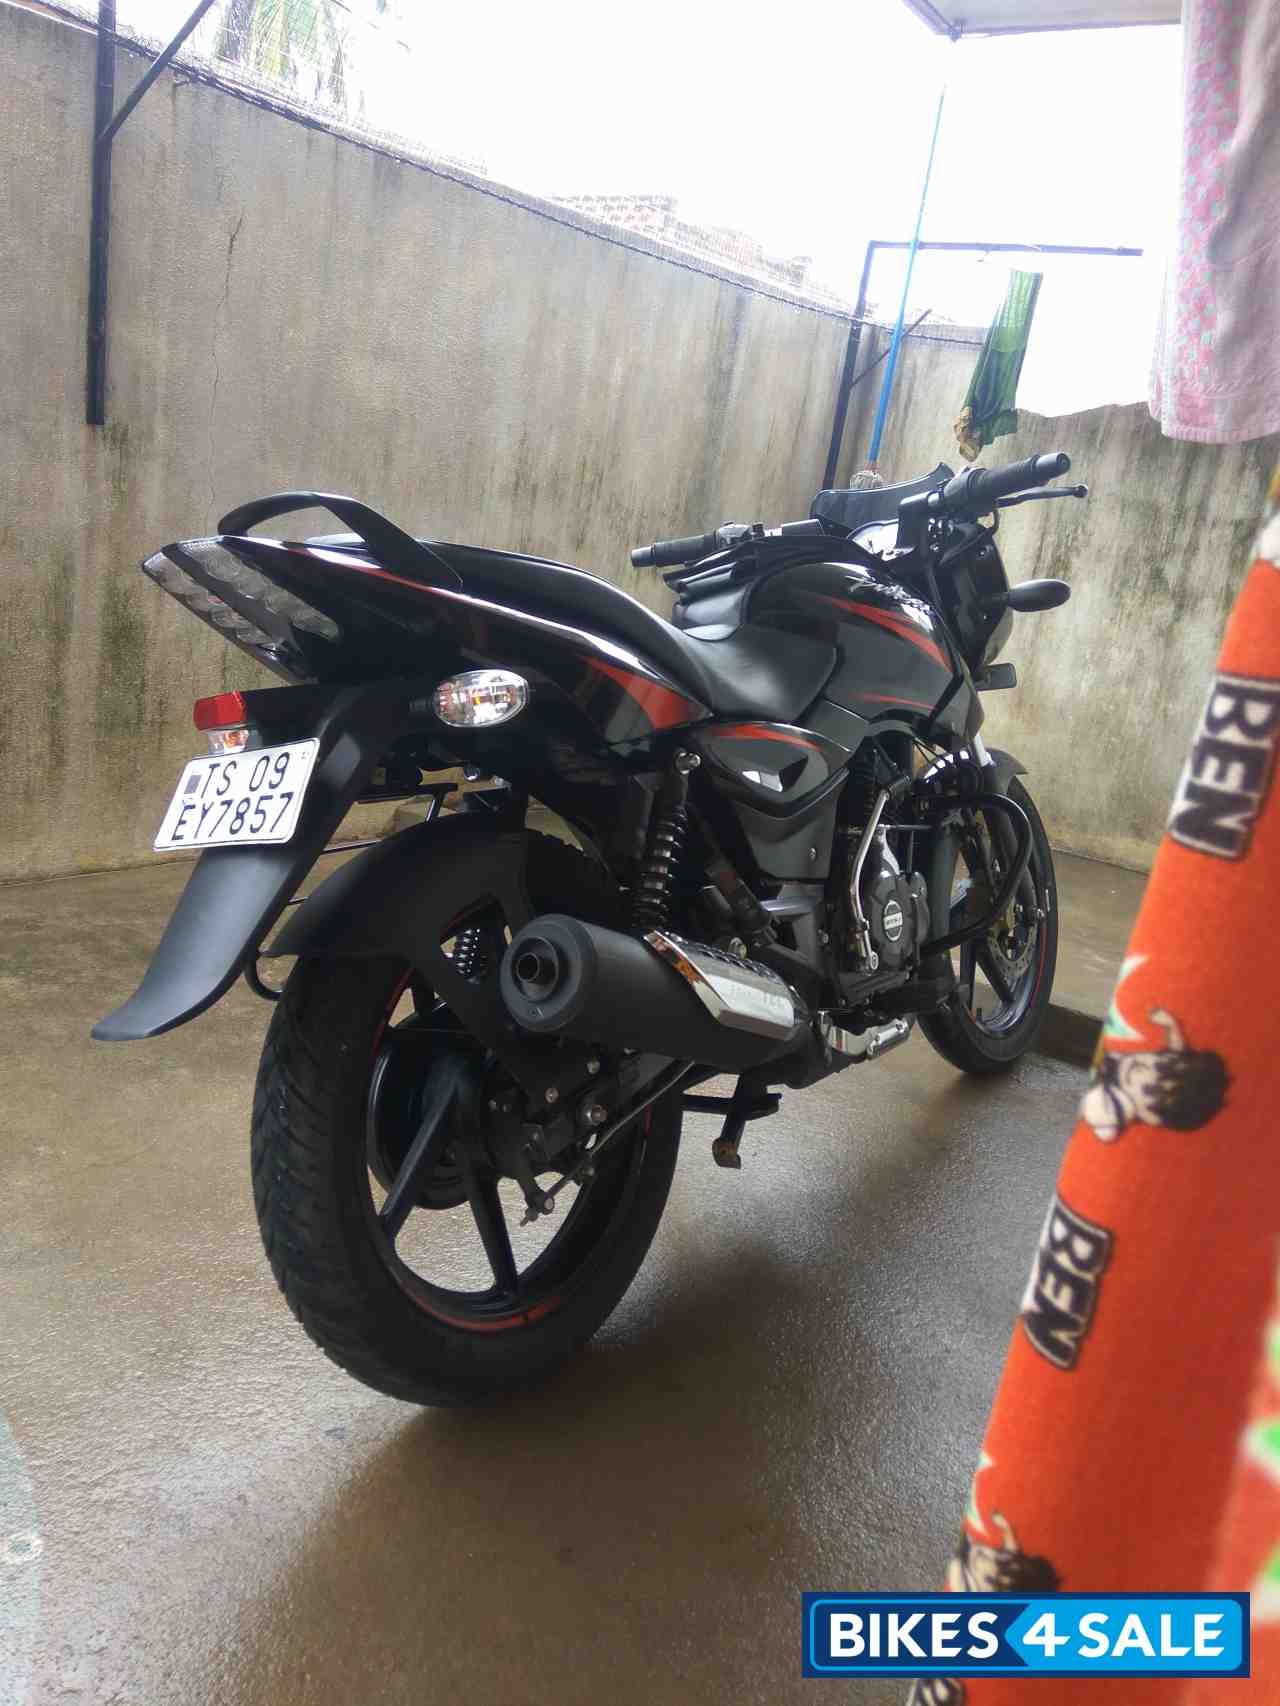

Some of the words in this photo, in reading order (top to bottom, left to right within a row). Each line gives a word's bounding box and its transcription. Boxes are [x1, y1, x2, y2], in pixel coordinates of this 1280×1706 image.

[171, 791, 295, 841] EY7857
[201, 760, 237, 800] TS
[248, 751, 290, 792] 09
[1173, 682, 1280, 850] BEN
[1024, 1202, 1104, 1358] BEN
